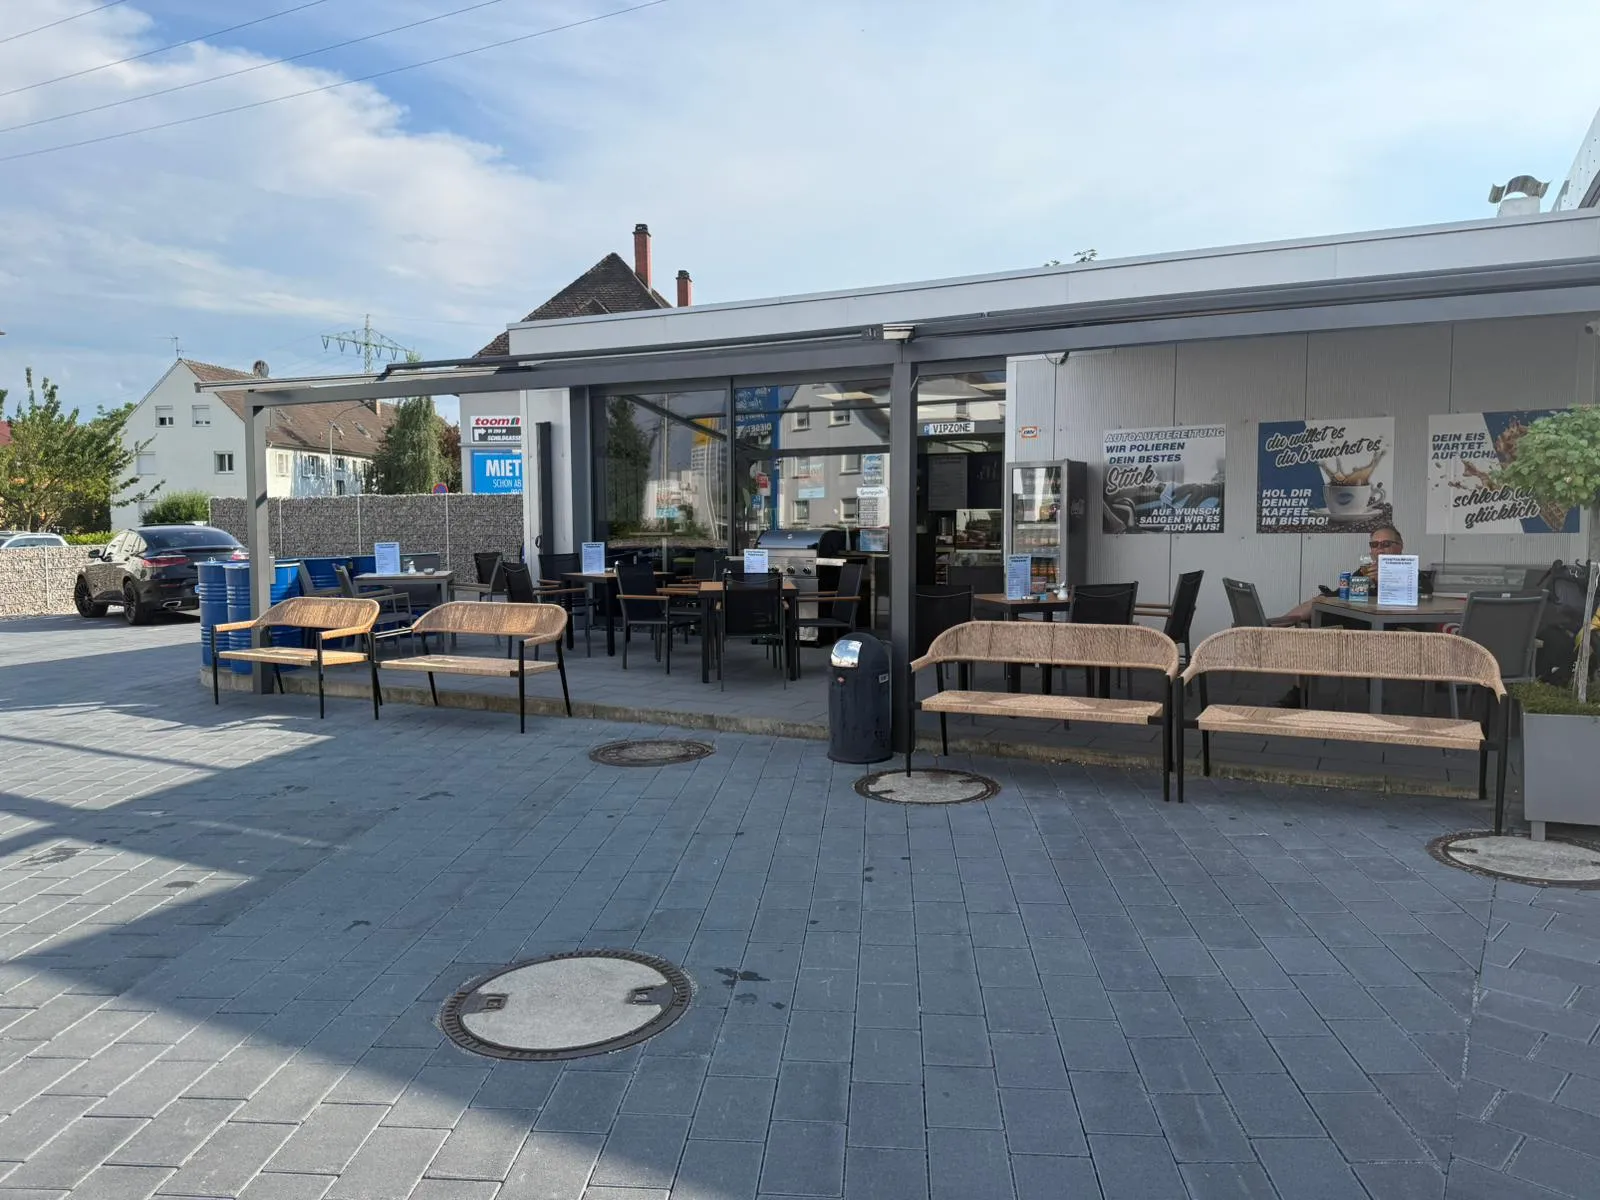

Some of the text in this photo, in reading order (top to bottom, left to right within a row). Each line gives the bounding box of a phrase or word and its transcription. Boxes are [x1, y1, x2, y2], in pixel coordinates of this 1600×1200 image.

[474, 417, 510, 425] toom
[933, 422, 971, 433] VIPZONE
[1105, 428, 1225, 443] AUTOAUFBEREITUNG
[1266, 426, 1346, 450] du willst es
[1432, 433, 1485, 442] DEIN EIS
[1106, 442, 1185, 453] WIR POLIEREN
[1432, 442, 1484, 451] WARTET
[1276, 439, 1382, 467] du brauchst es
[1431, 450, 1495, 460] AUF DICH!
[1109, 454, 1181, 464] DEIN BESTES
[1106, 464, 1156, 494] Stück
[1262, 488, 1312, 498] HOL DIR
[1453, 484, 1510, 507] schleck
[1262, 498, 1308, 507] DEINEN
[1151, 507, 1220, 516] AUF WUNSCH
[1261, 508, 1309, 516] KAFFEE
[1465, 501, 1540, 528] glücklich
[1140, 515, 1220, 524] SAUGEN WIR ES
[1261, 517, 1329, 526] IM BISTRO!
[1195, 523, 1220, 531] AUS!
